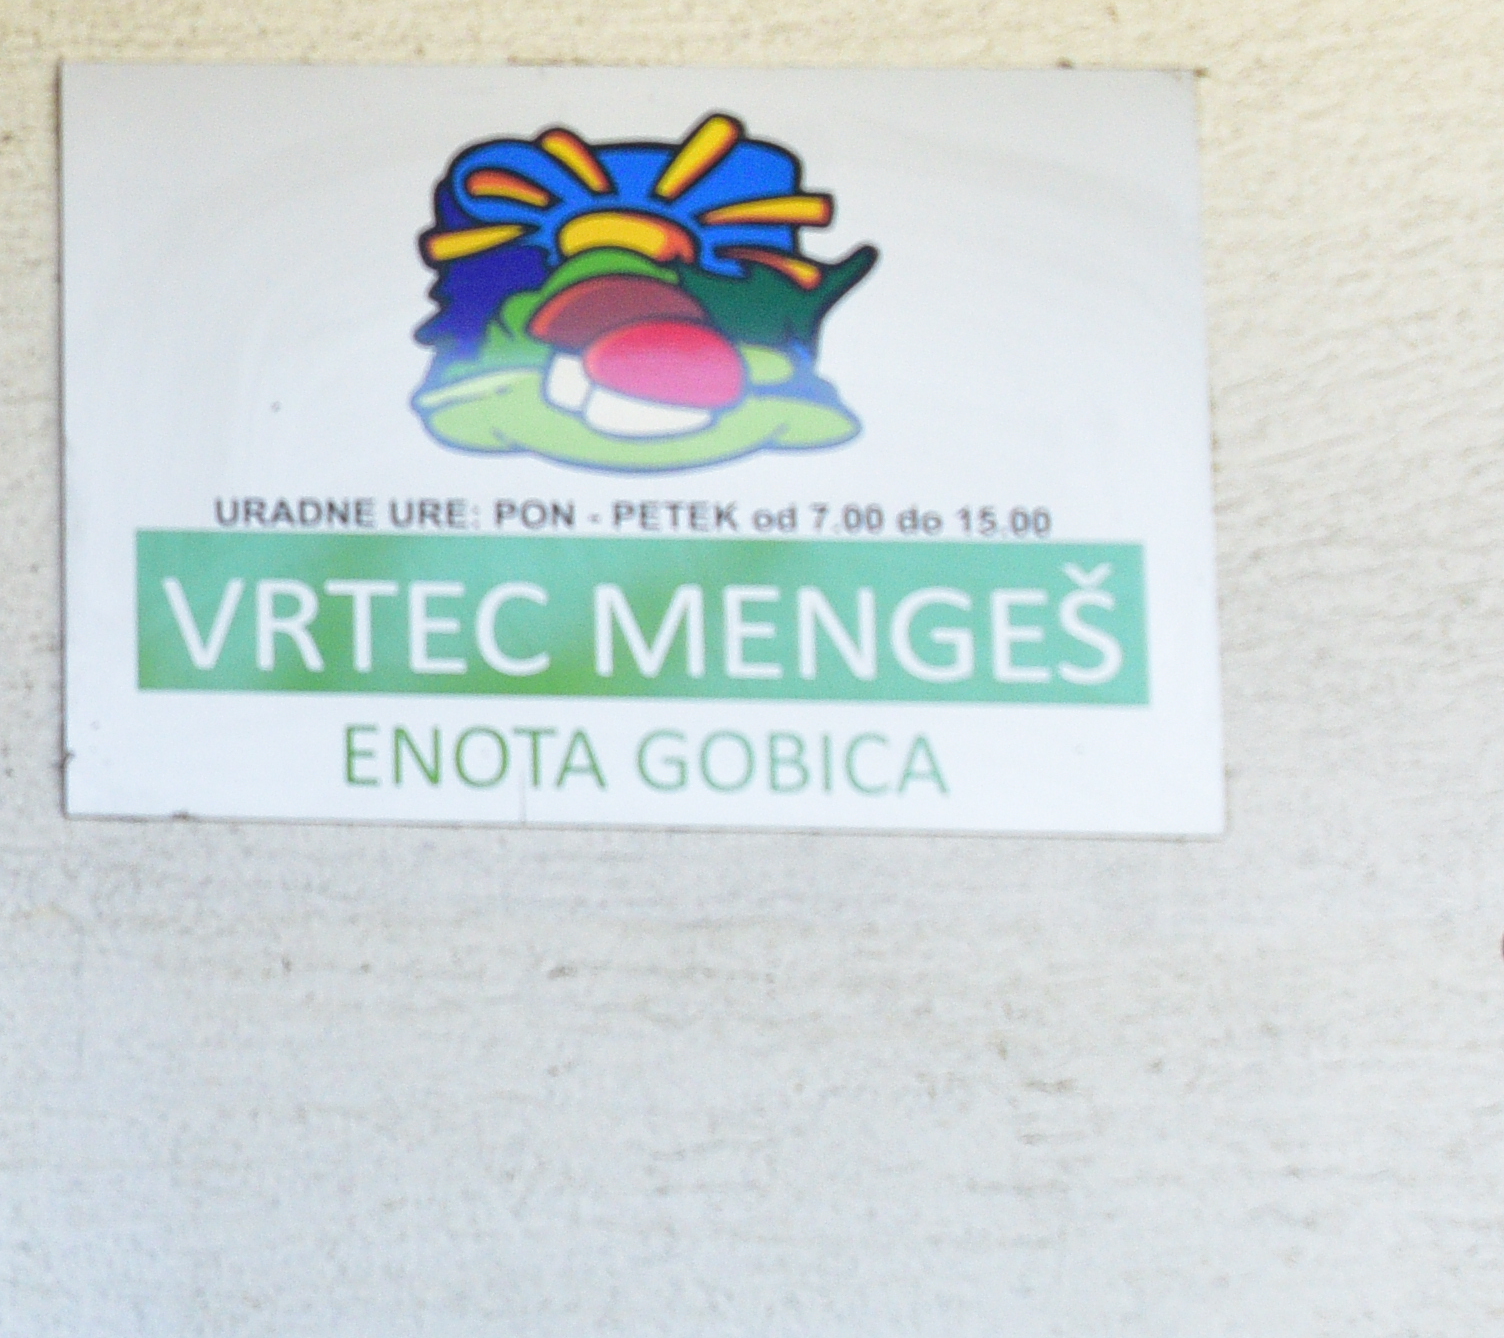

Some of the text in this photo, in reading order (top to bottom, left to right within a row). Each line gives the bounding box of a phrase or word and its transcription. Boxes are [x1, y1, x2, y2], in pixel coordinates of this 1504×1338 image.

[214, 496, 375, 528] URADNE
[390, 497, 481, 530] URE:
[494, 498, 576, 530] PON
[613, 500, 739, 532] PETEK
[752, 504, 797, 533] od
[810, 504, 885, 534] 7.00
[897, 505, 944, 534] do
[957, 506, 1053, 537] 15.00
[162, 562, 1125, 686] VRTEC MENGEŠ
[345, 722, 949, 797] ENOTA GOBICA
